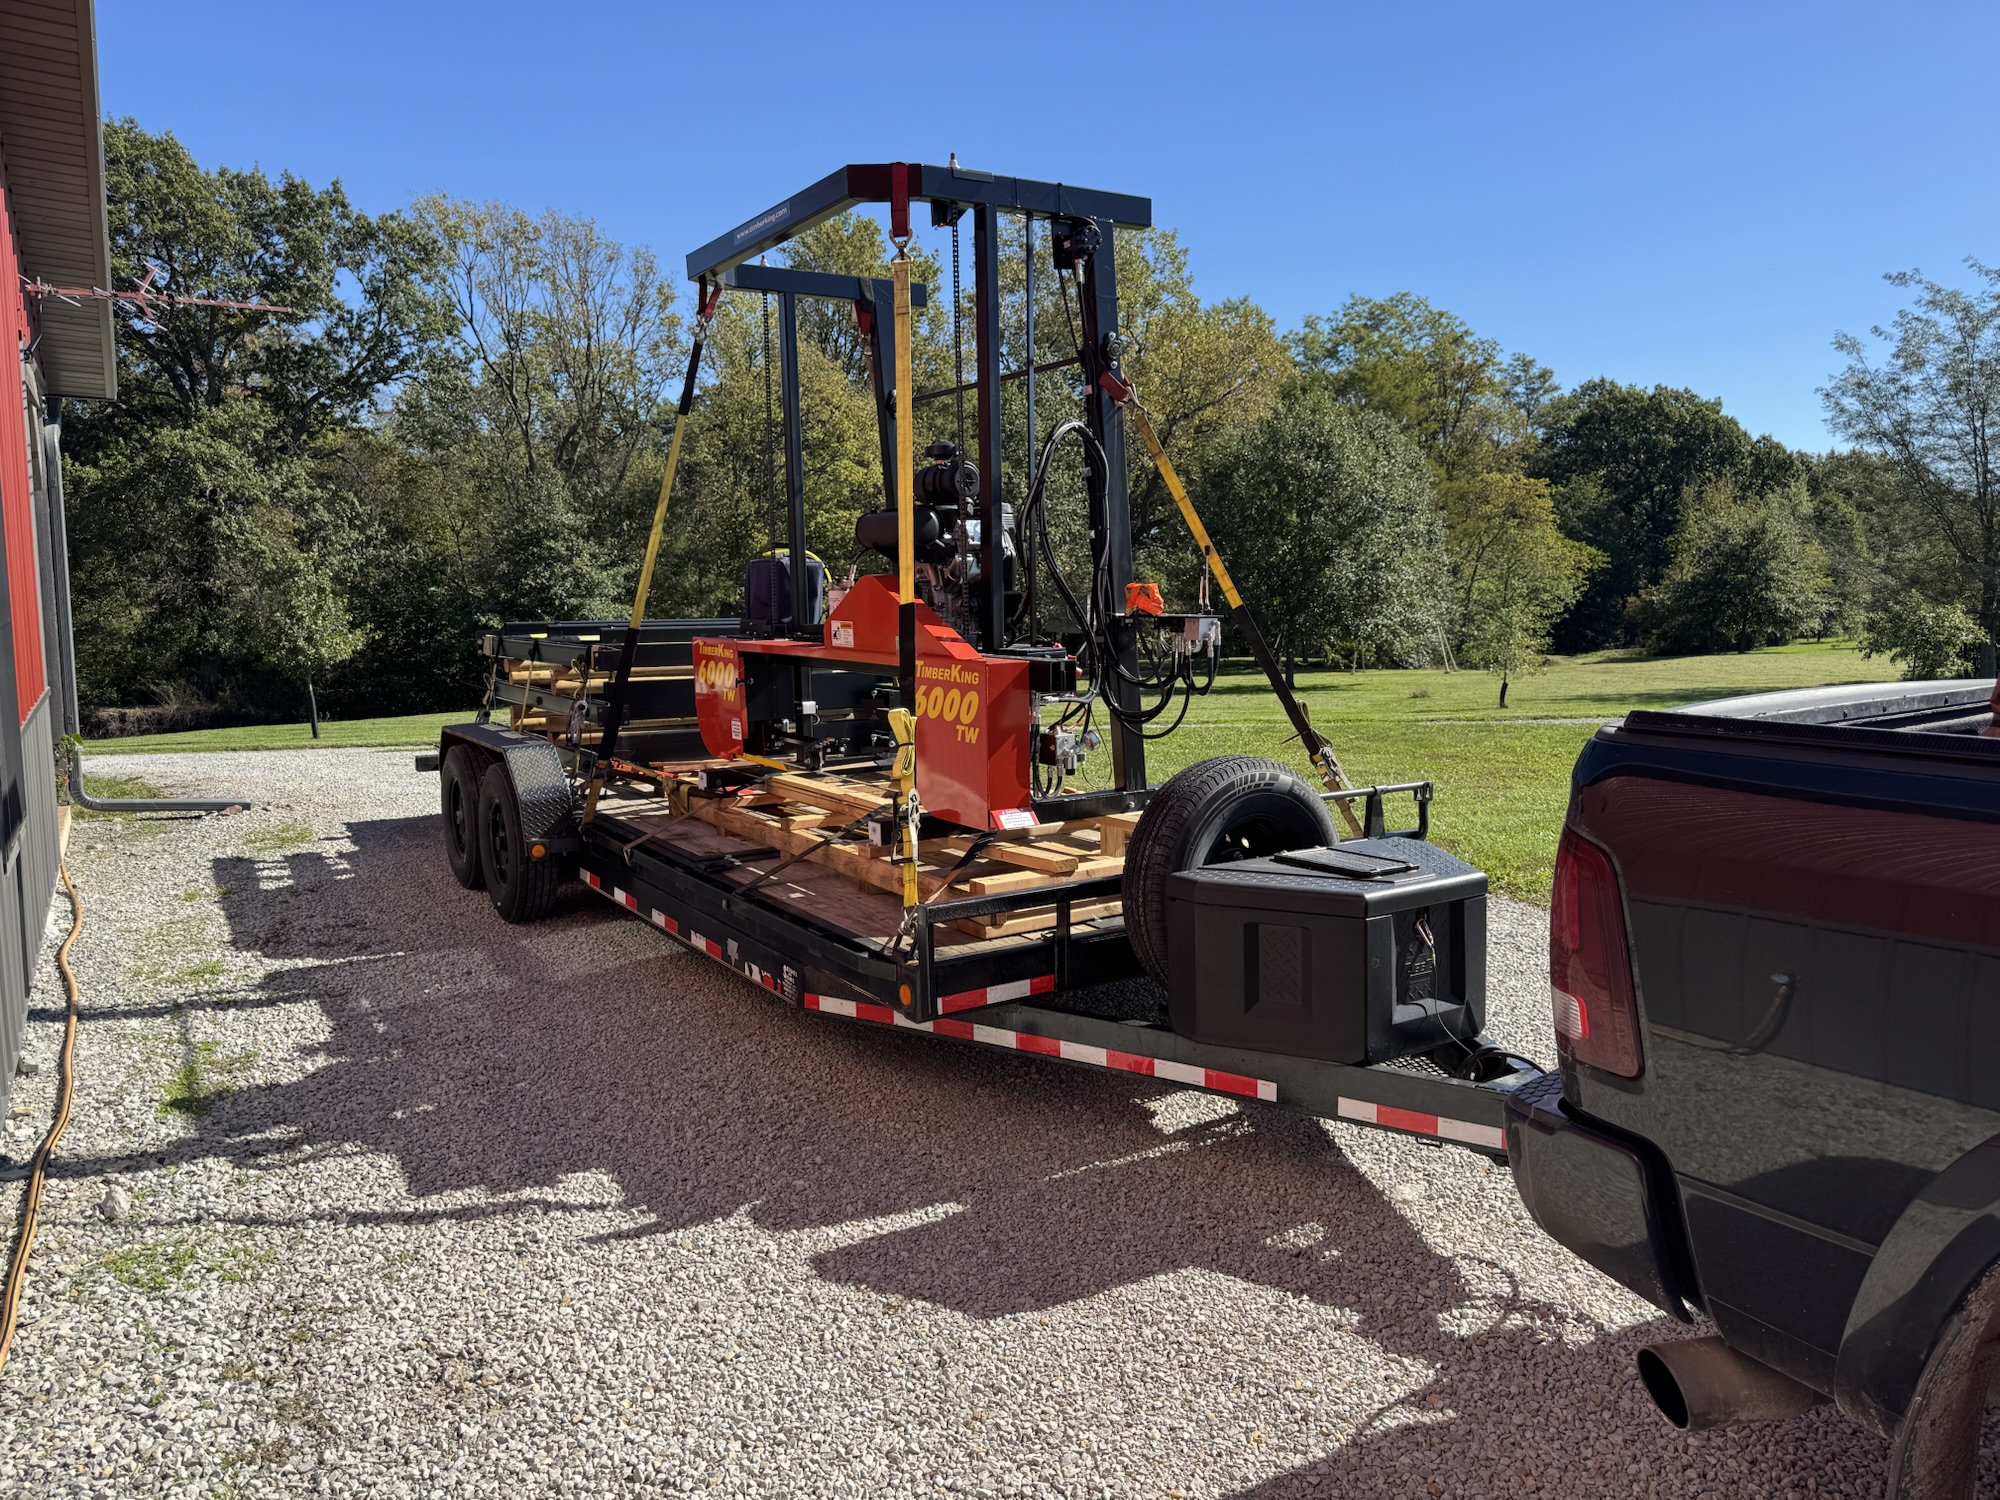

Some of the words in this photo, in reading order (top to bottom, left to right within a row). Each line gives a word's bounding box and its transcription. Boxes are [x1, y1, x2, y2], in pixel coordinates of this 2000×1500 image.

[698, 660, 735, 688] 6000
[722, 687, 736, 702] TW
[915, 684, 979, 725] 6000
[955, 724, 980, 744] TW
